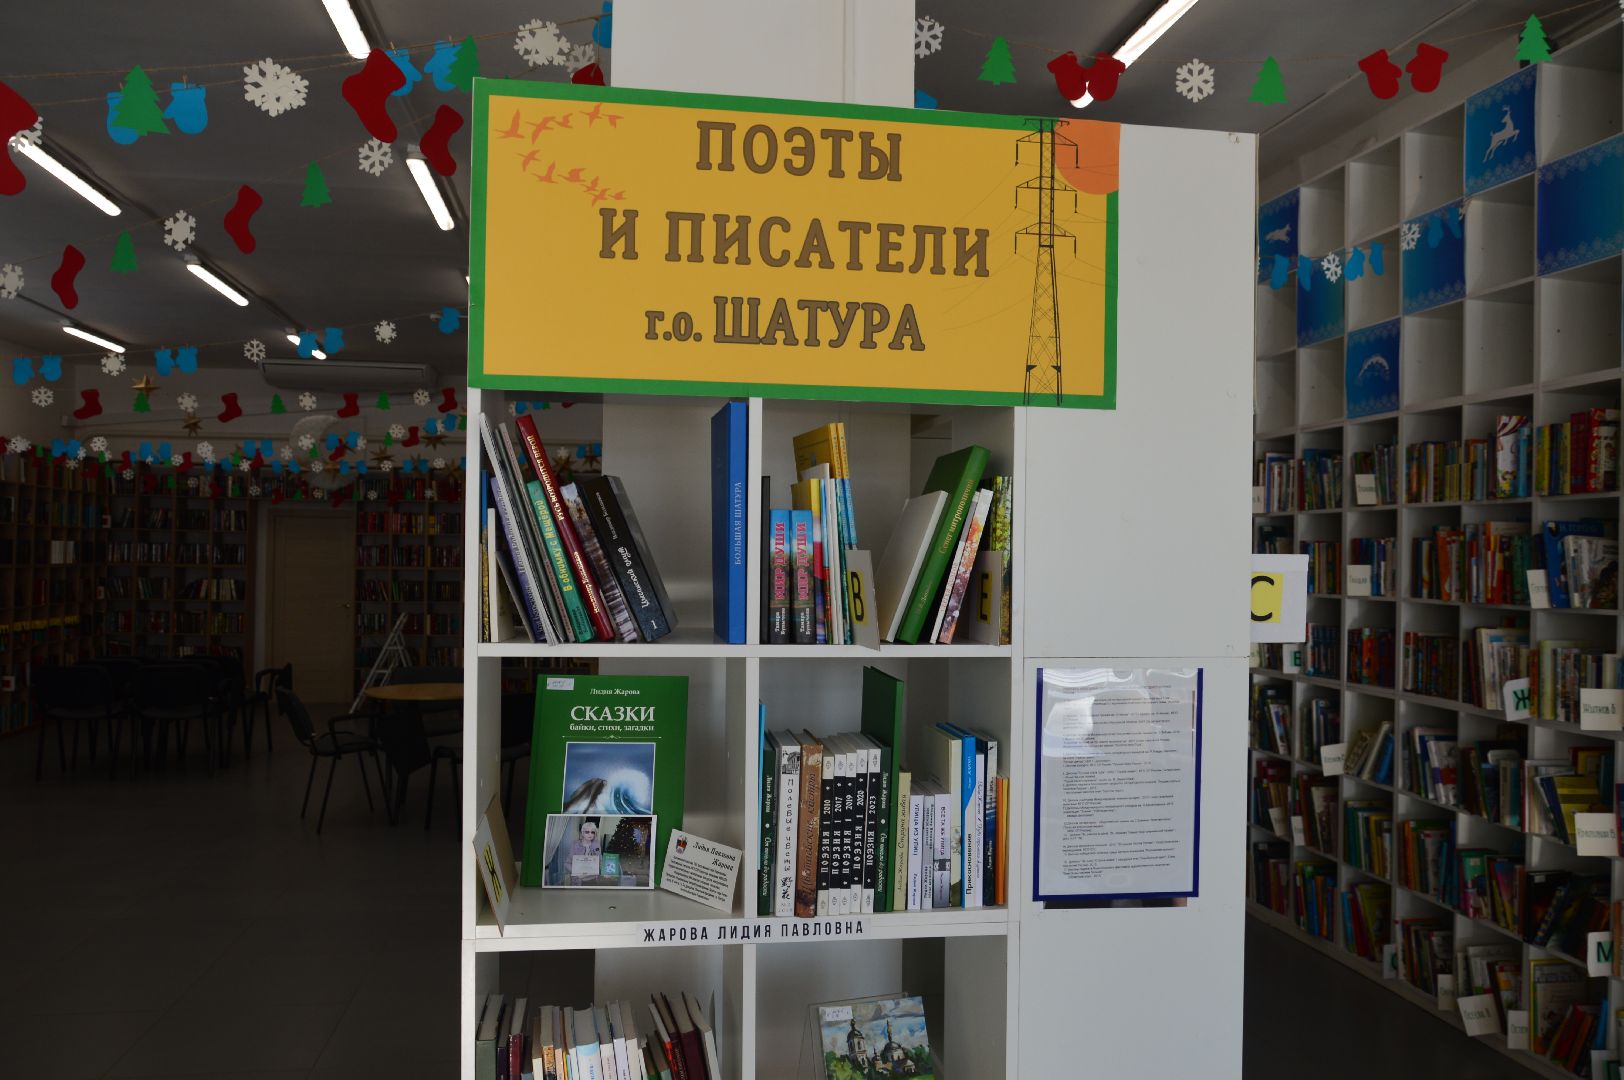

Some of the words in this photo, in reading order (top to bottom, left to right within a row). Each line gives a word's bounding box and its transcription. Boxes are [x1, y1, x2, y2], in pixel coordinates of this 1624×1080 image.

[696, 120, 902, 181] ПОЭТЫ
[599, 208, 639, 259] И
[665, 211, 990, 277] ПИСАТЕЛИ
[645, 310, 702, 343] г.о.
[714, 296, 925, 350] ШАТУРА
[534, 456, 559, 502] ВОЗРОДИТСЯ
[552, 501, 565, 520] РУСЬ
[734, 482, 742, 518] ШАТУРА
[533, 498, 555, 540] Мещёрой
[775, 522, 788, 565] ДУШИ
[797, 522, 809, 566] ДУШИ
[550, 546, 570, 584] обнимку
[562, 584, 573, 592] В
[775, 568, 785, 600] МИР
[798, 568, 808, 600] МИР
[571, 706, 656, 721] СКАЗКИ
[834, 796, 842, 812] 2017
[845, 794, 853, 809] 2019
[856, 789, 864, 805] 2020
[644, 927, 708, 942] ЖАРОВА
[718, 925, 771, 940] ЛИДИЯ
[781, 921, 863, 936] ПАВЛОВНА
